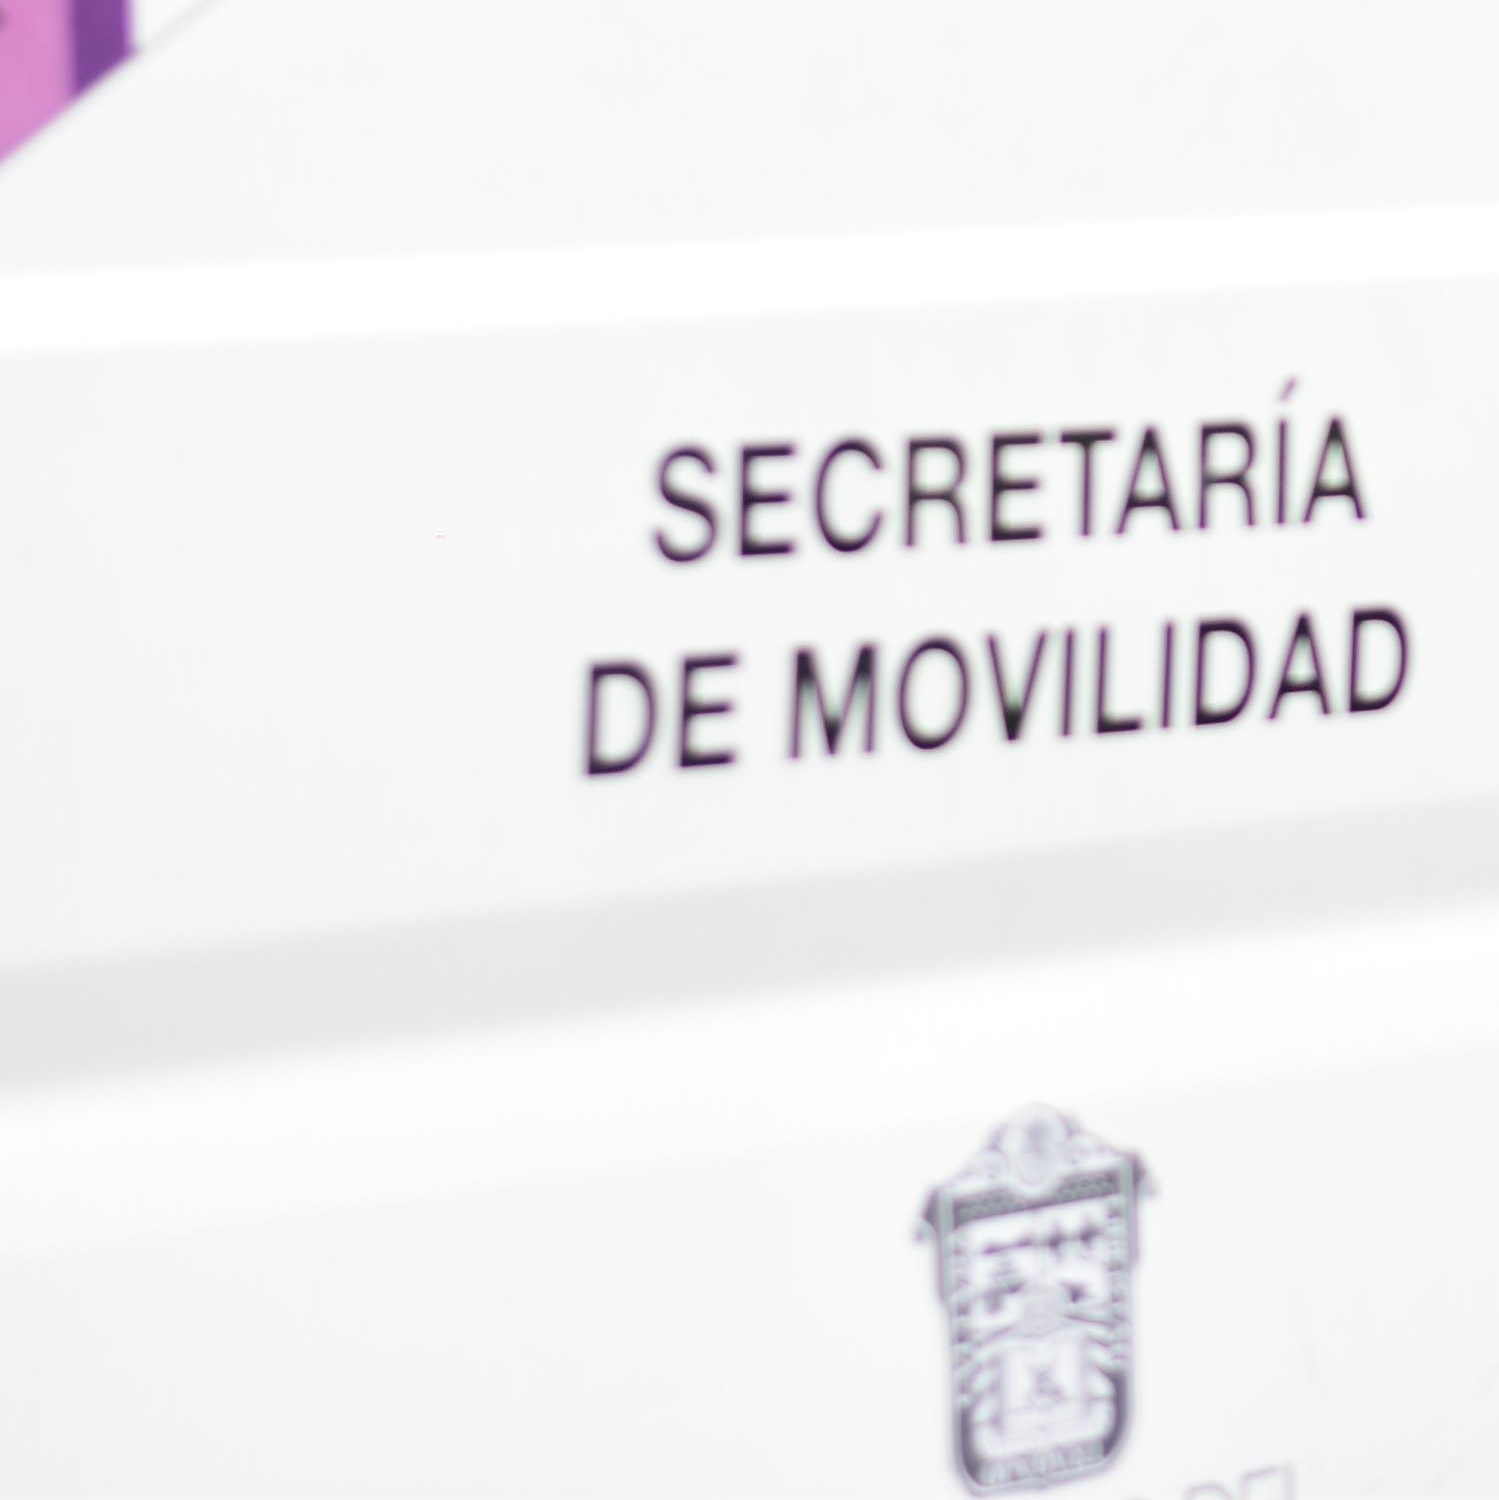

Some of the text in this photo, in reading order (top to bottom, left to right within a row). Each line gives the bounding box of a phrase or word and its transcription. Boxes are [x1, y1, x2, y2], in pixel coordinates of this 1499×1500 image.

[651, 377, 1369, 566] SECRETARÍA
[581, 602, 1413, 780] DE MOVILIDAD
